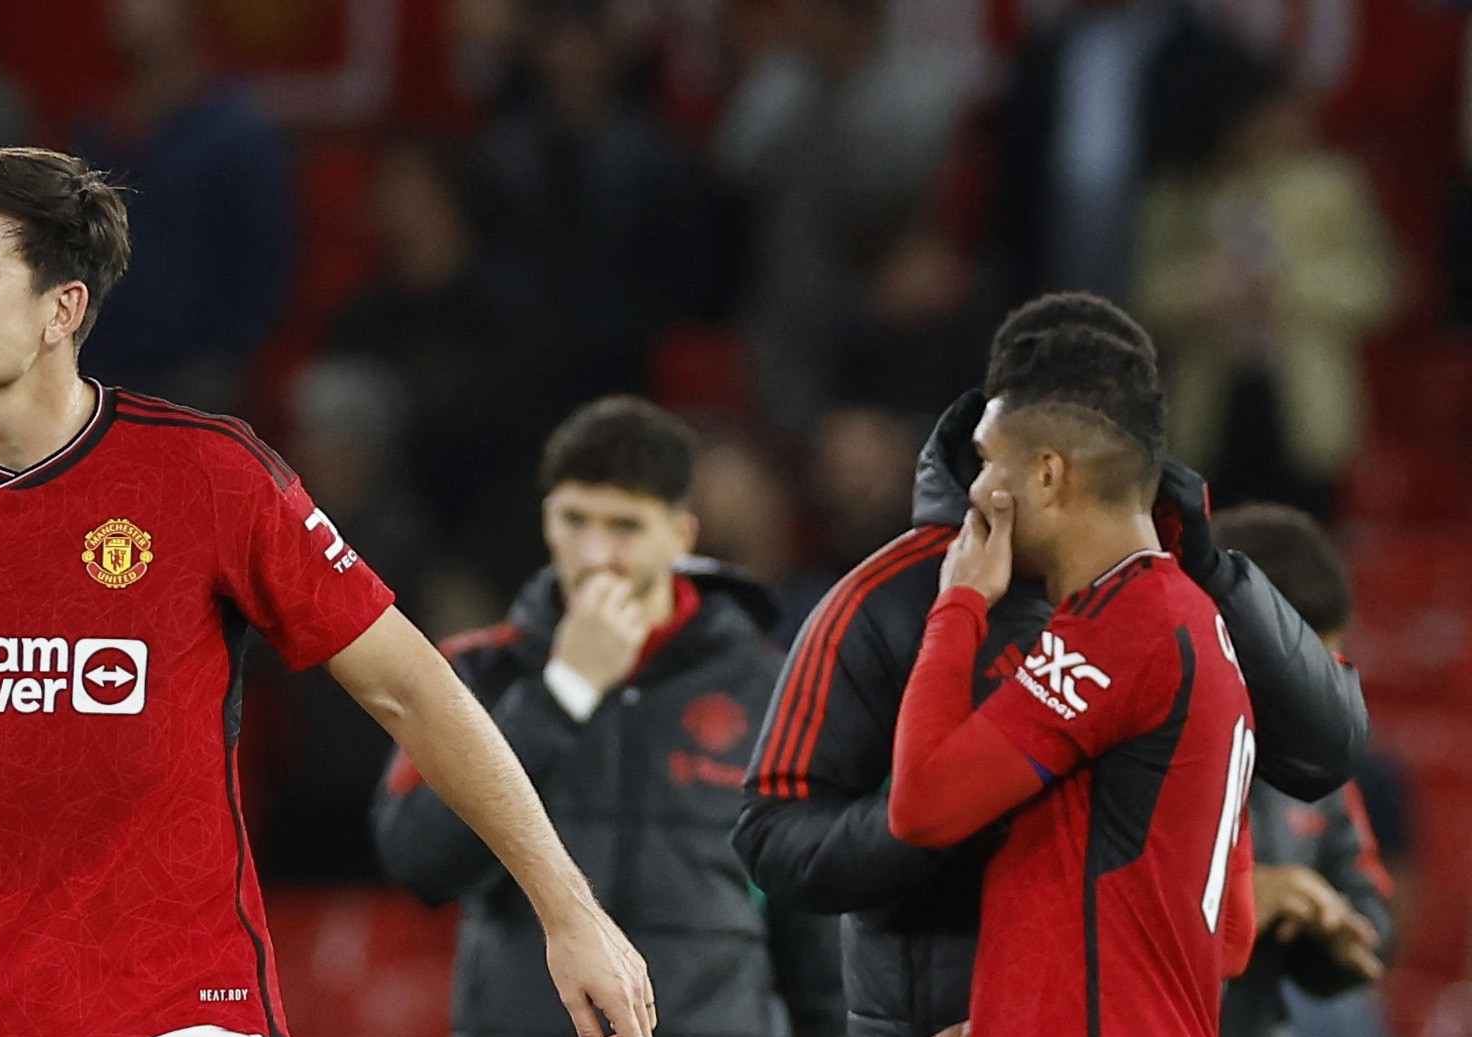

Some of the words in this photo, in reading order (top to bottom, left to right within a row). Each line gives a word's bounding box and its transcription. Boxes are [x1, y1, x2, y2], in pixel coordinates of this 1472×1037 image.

[90, 523, 147, 546] MANCHESTER
[97, 571, 137, 584] UNITED
[199, 988, 248, 1002] HEAT.RDY
